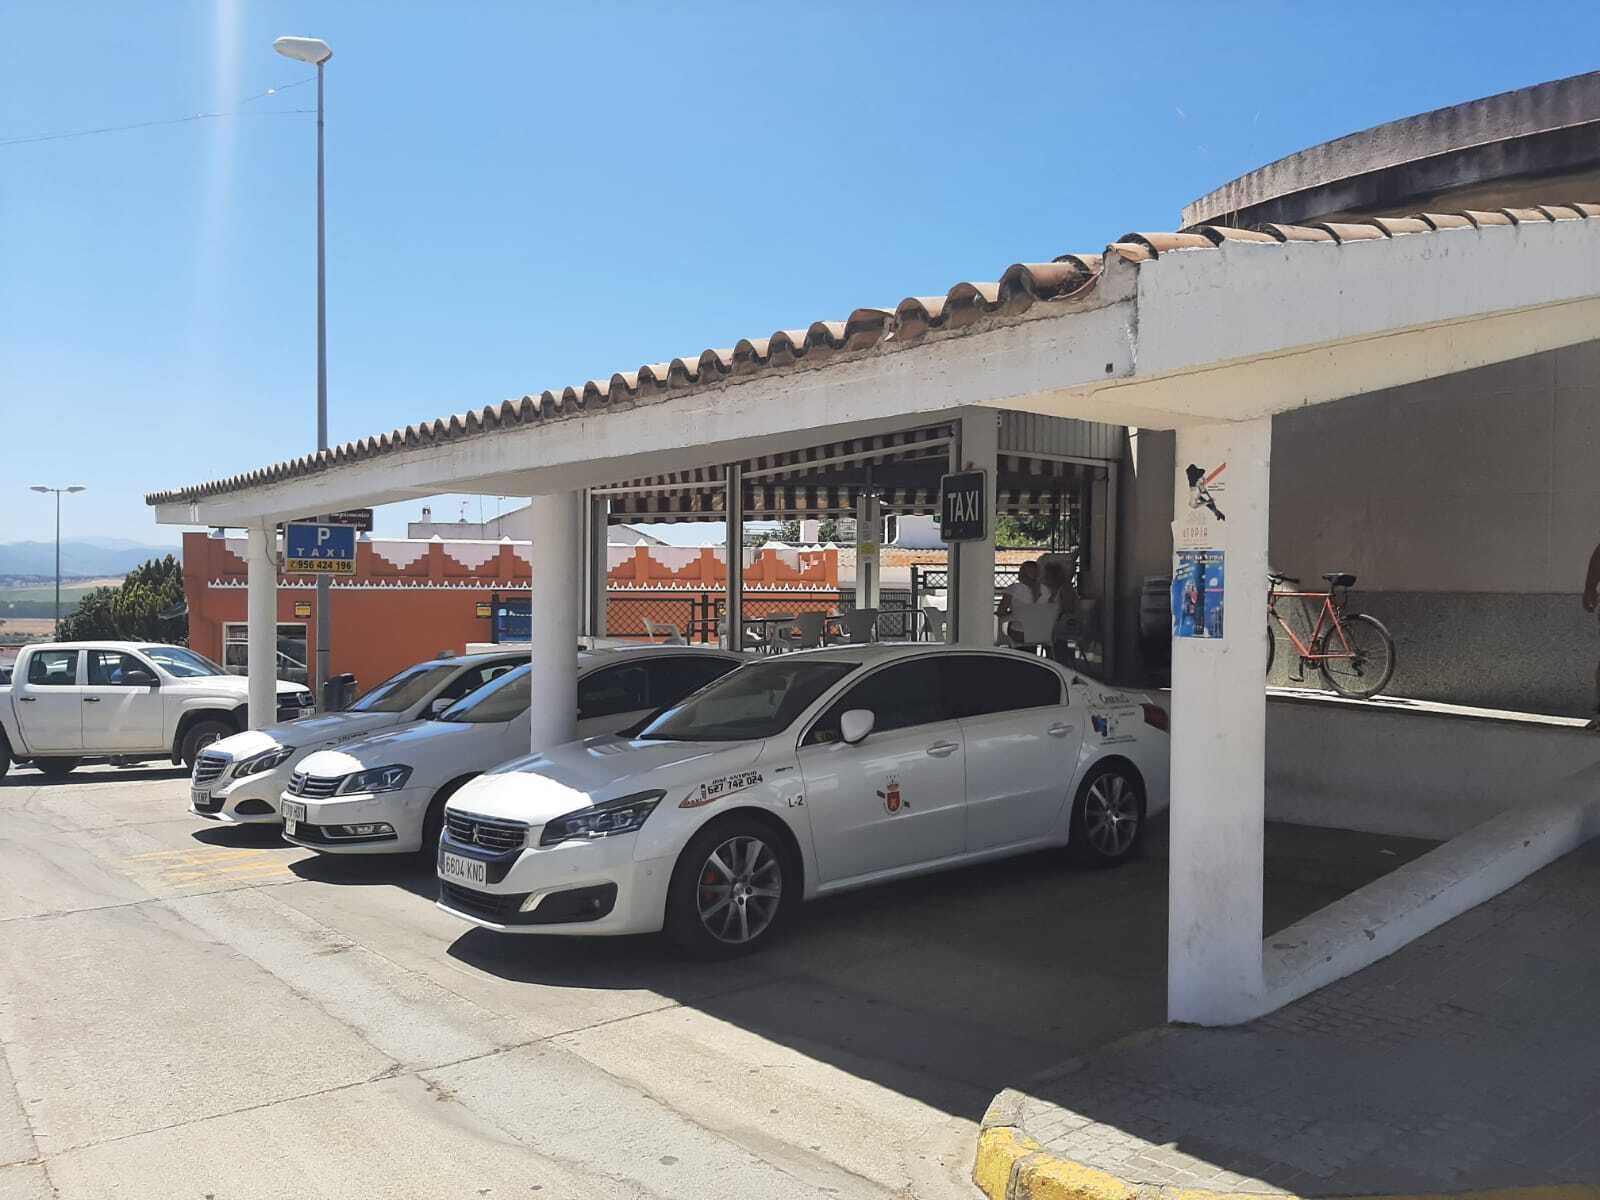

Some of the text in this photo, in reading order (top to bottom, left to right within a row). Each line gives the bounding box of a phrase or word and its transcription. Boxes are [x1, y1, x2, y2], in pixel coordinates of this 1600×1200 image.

[947, 490, 979, 522] TAXI
[318, 527, 331, 546] P
[296, 547, 345, 557] TAXI
[298, 560, 352, 570] 956 424 196
[707, 774, 763, 794] 627 742 024
[788, 795, 804, 808] L-2
[446, 856, 485, 882] 6604 KND
